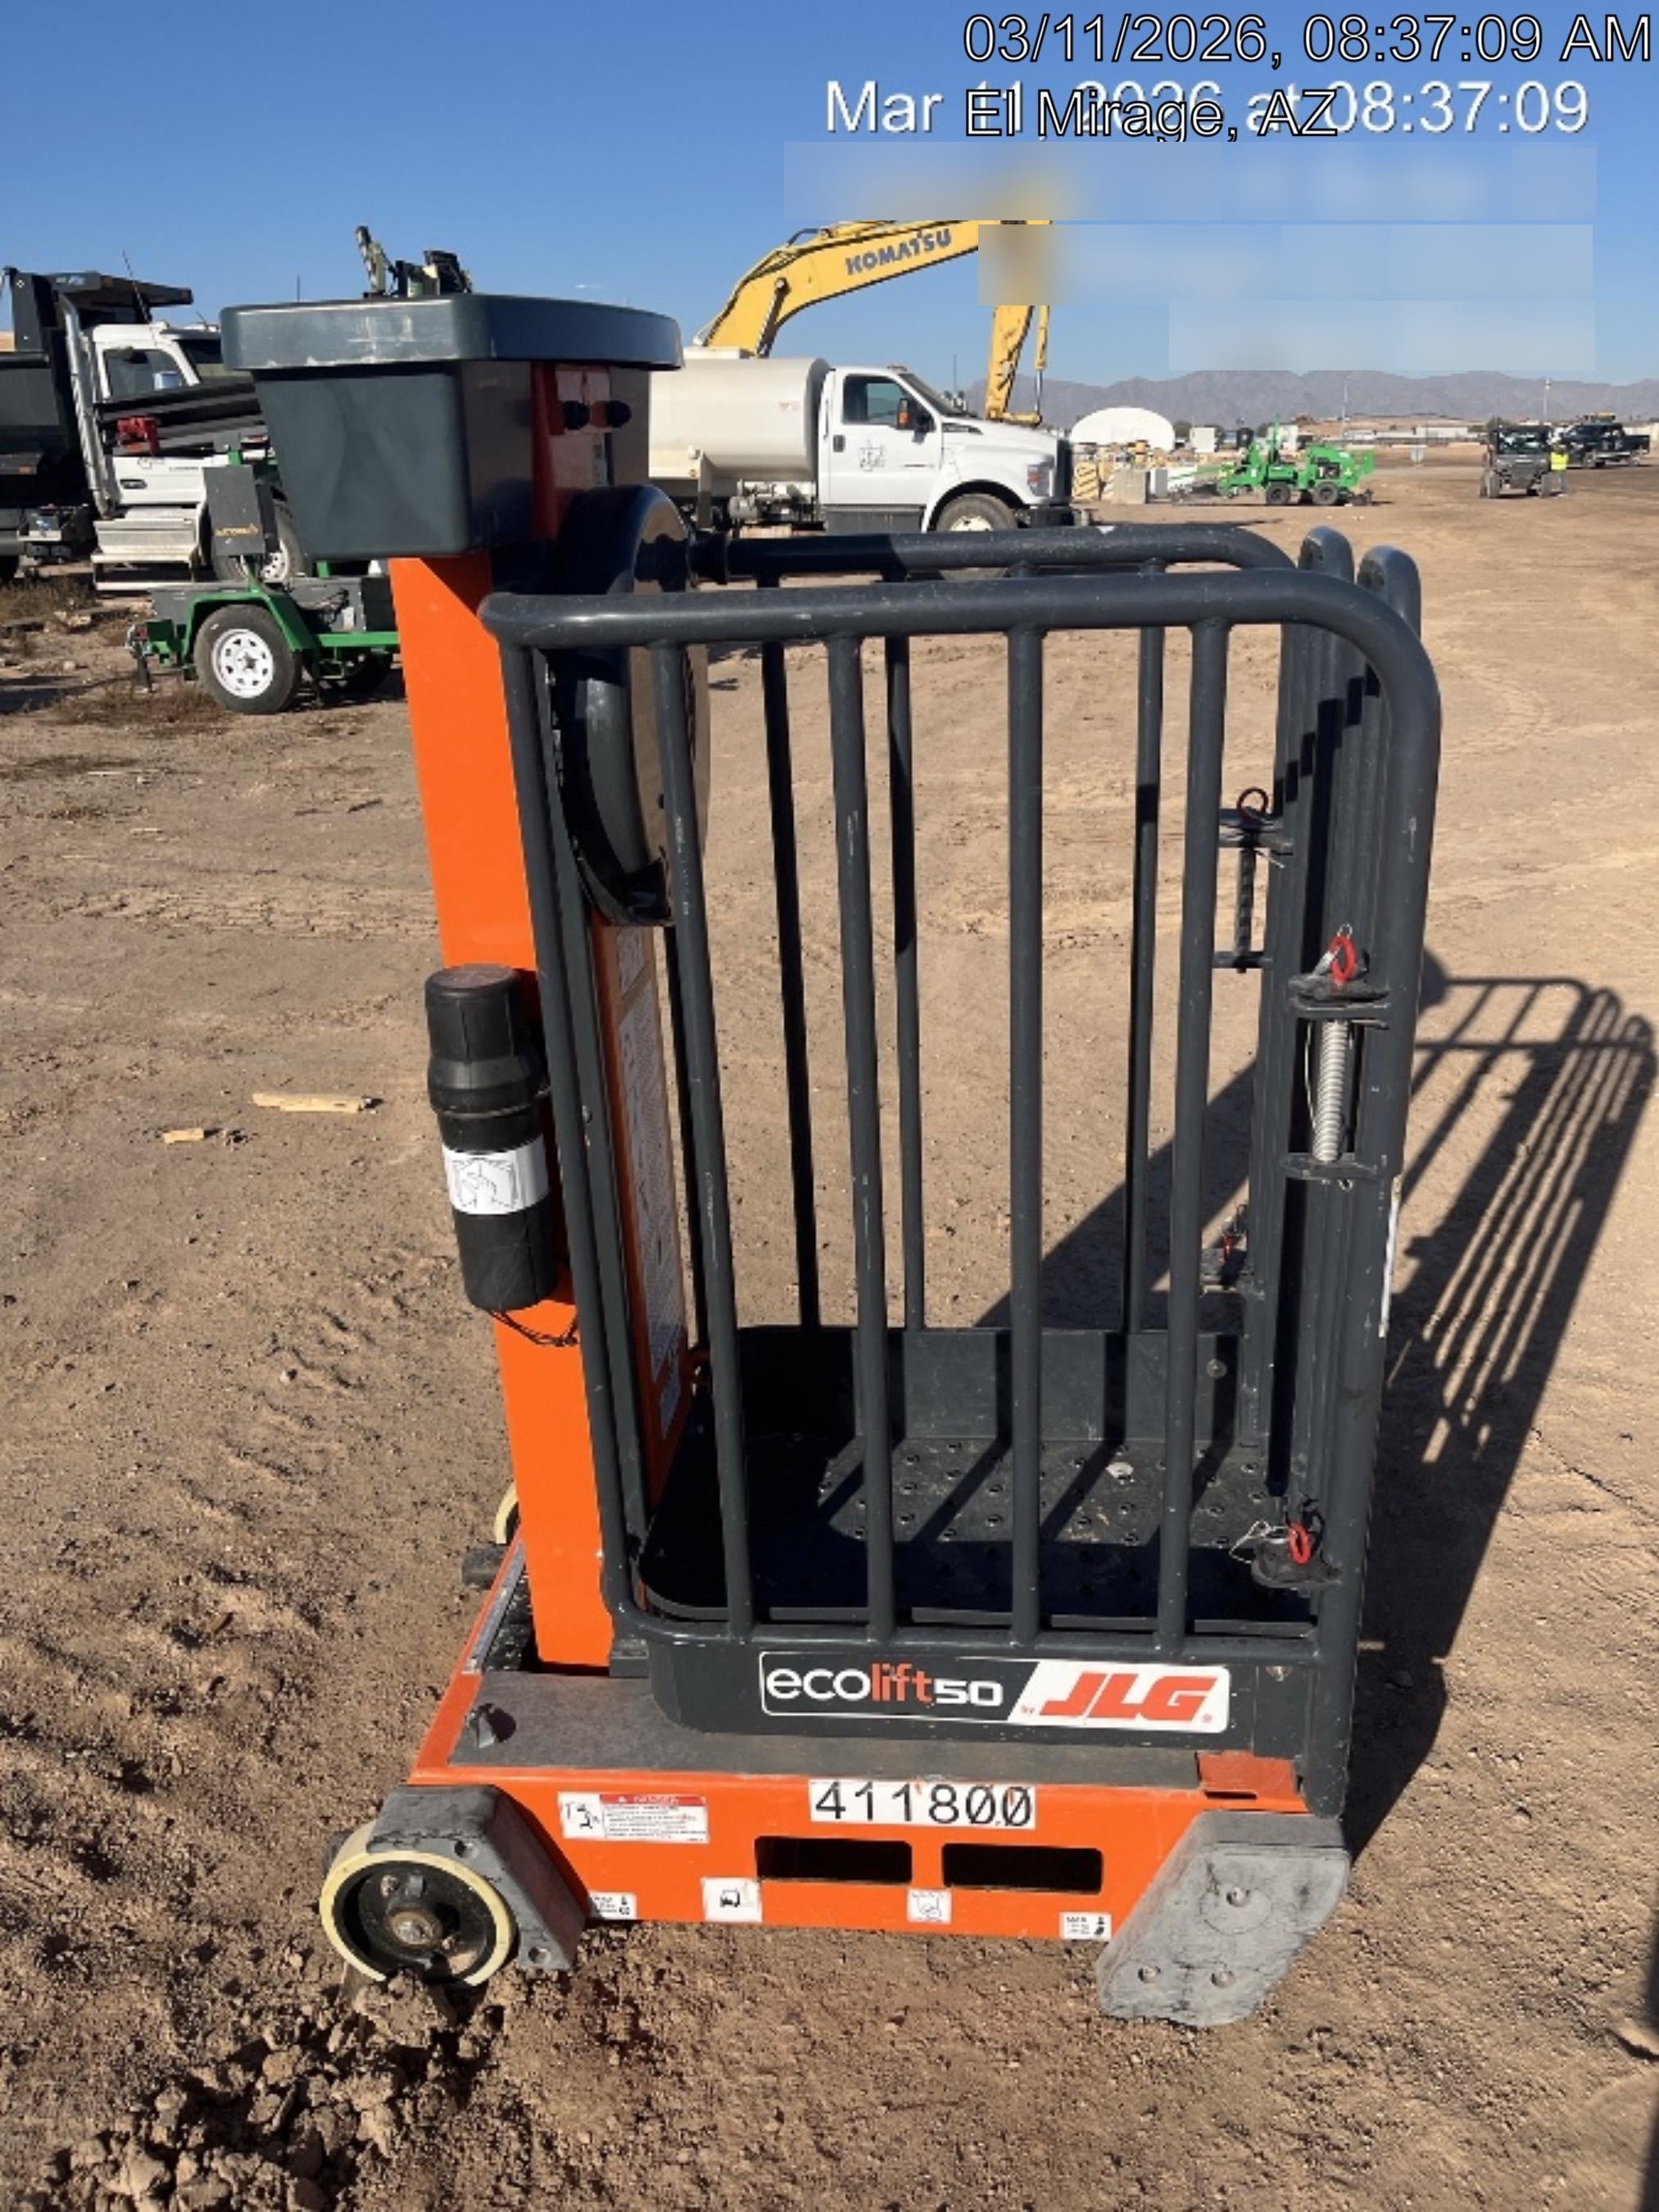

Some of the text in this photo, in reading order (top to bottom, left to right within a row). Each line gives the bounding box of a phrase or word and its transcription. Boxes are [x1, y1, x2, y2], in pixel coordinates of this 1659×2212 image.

[845, 228, 952, 276] KOMATSU
[1039, 1671, 1219, 1723] JLG
[815, 1780, 1031, 1827] 411800
